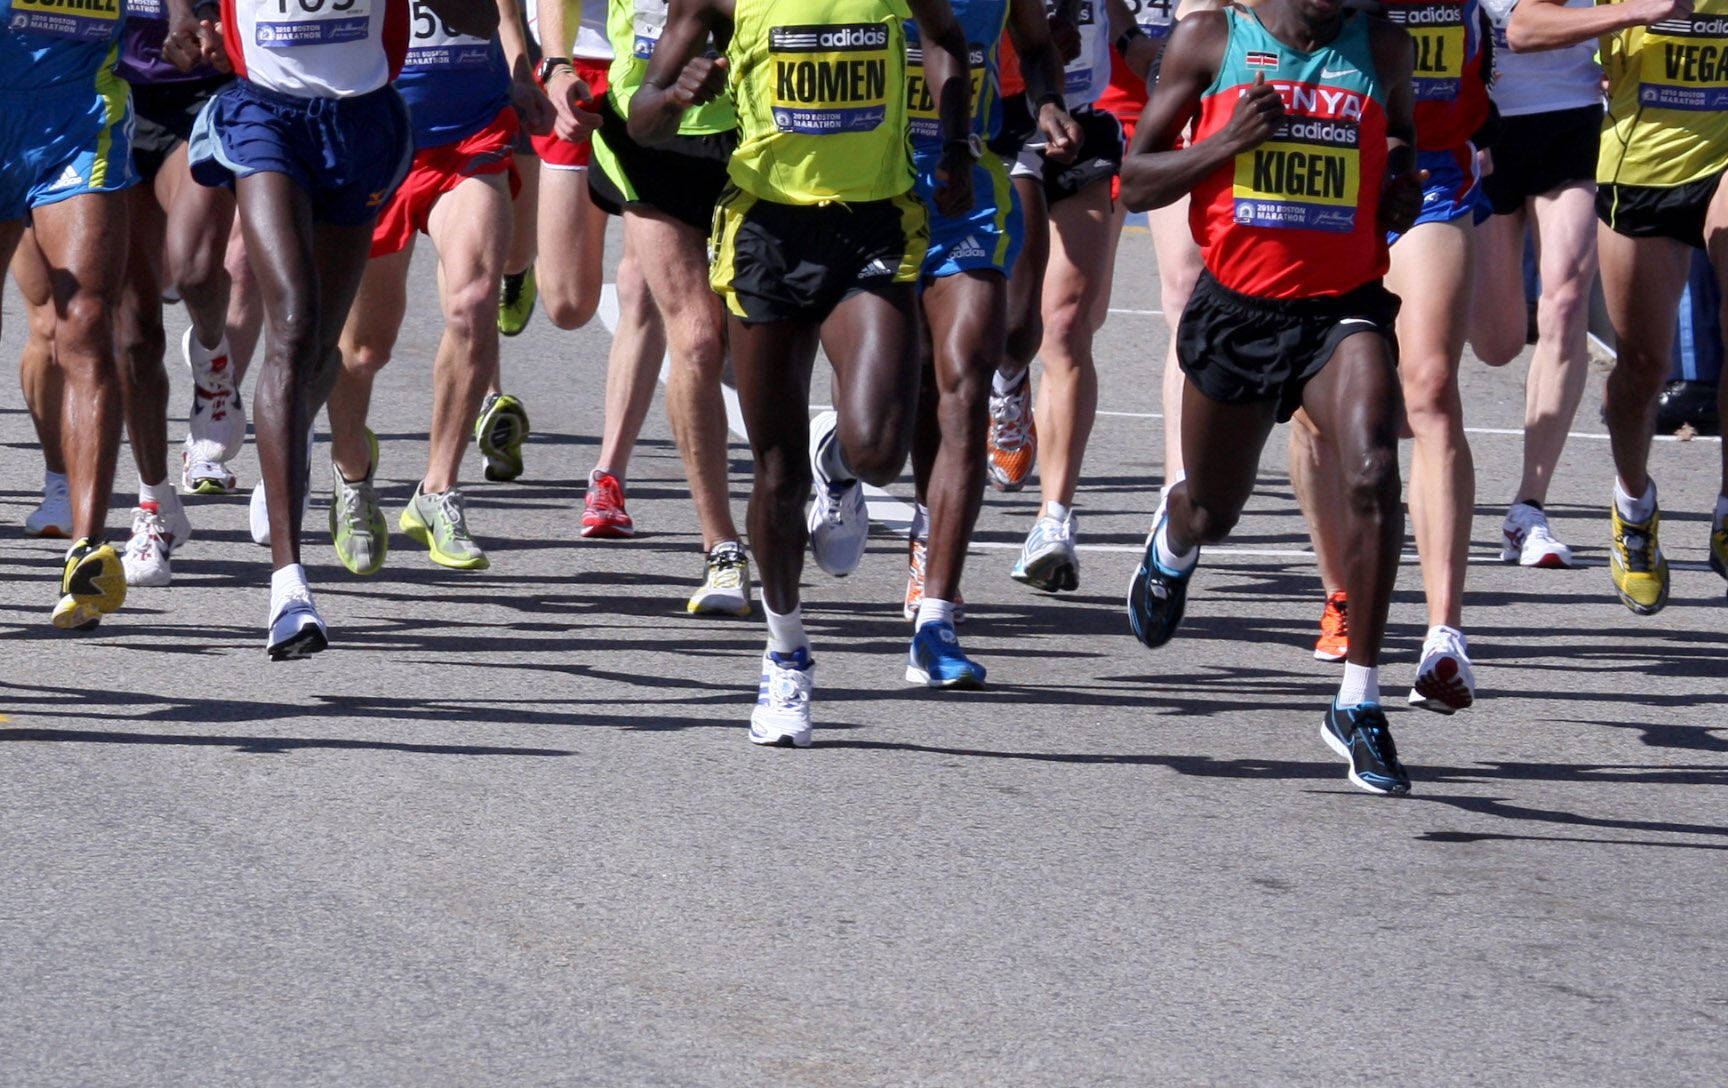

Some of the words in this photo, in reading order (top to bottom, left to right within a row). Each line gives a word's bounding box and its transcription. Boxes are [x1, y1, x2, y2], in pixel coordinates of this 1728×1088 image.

[1408, 6, 1461, 24] adidas
[49, 16, 76, 26] BOSTON
[29, 21, 76, 33] MARATHON
[276, 31, 321, 40] MARATHON
[820, 29, 886, 47] adidas
[776, 59, 886, 103] KOMEN
[1239, 84, 1362, 123] ENYA
[1659, 95, 1706, 106] MARATHON
[810, 113, 842, 121] BOSTON
[793, 120, 842, 129] MARATHON
[1291, 122, 1357, 143] adidas
[1252, 149, 1346, 199] KIGEN
[1276, 205, 1306, 214] BOSTON
[1256, 211, 1306, 222] MARATHON
[950, 249, 985, 259] adidas
